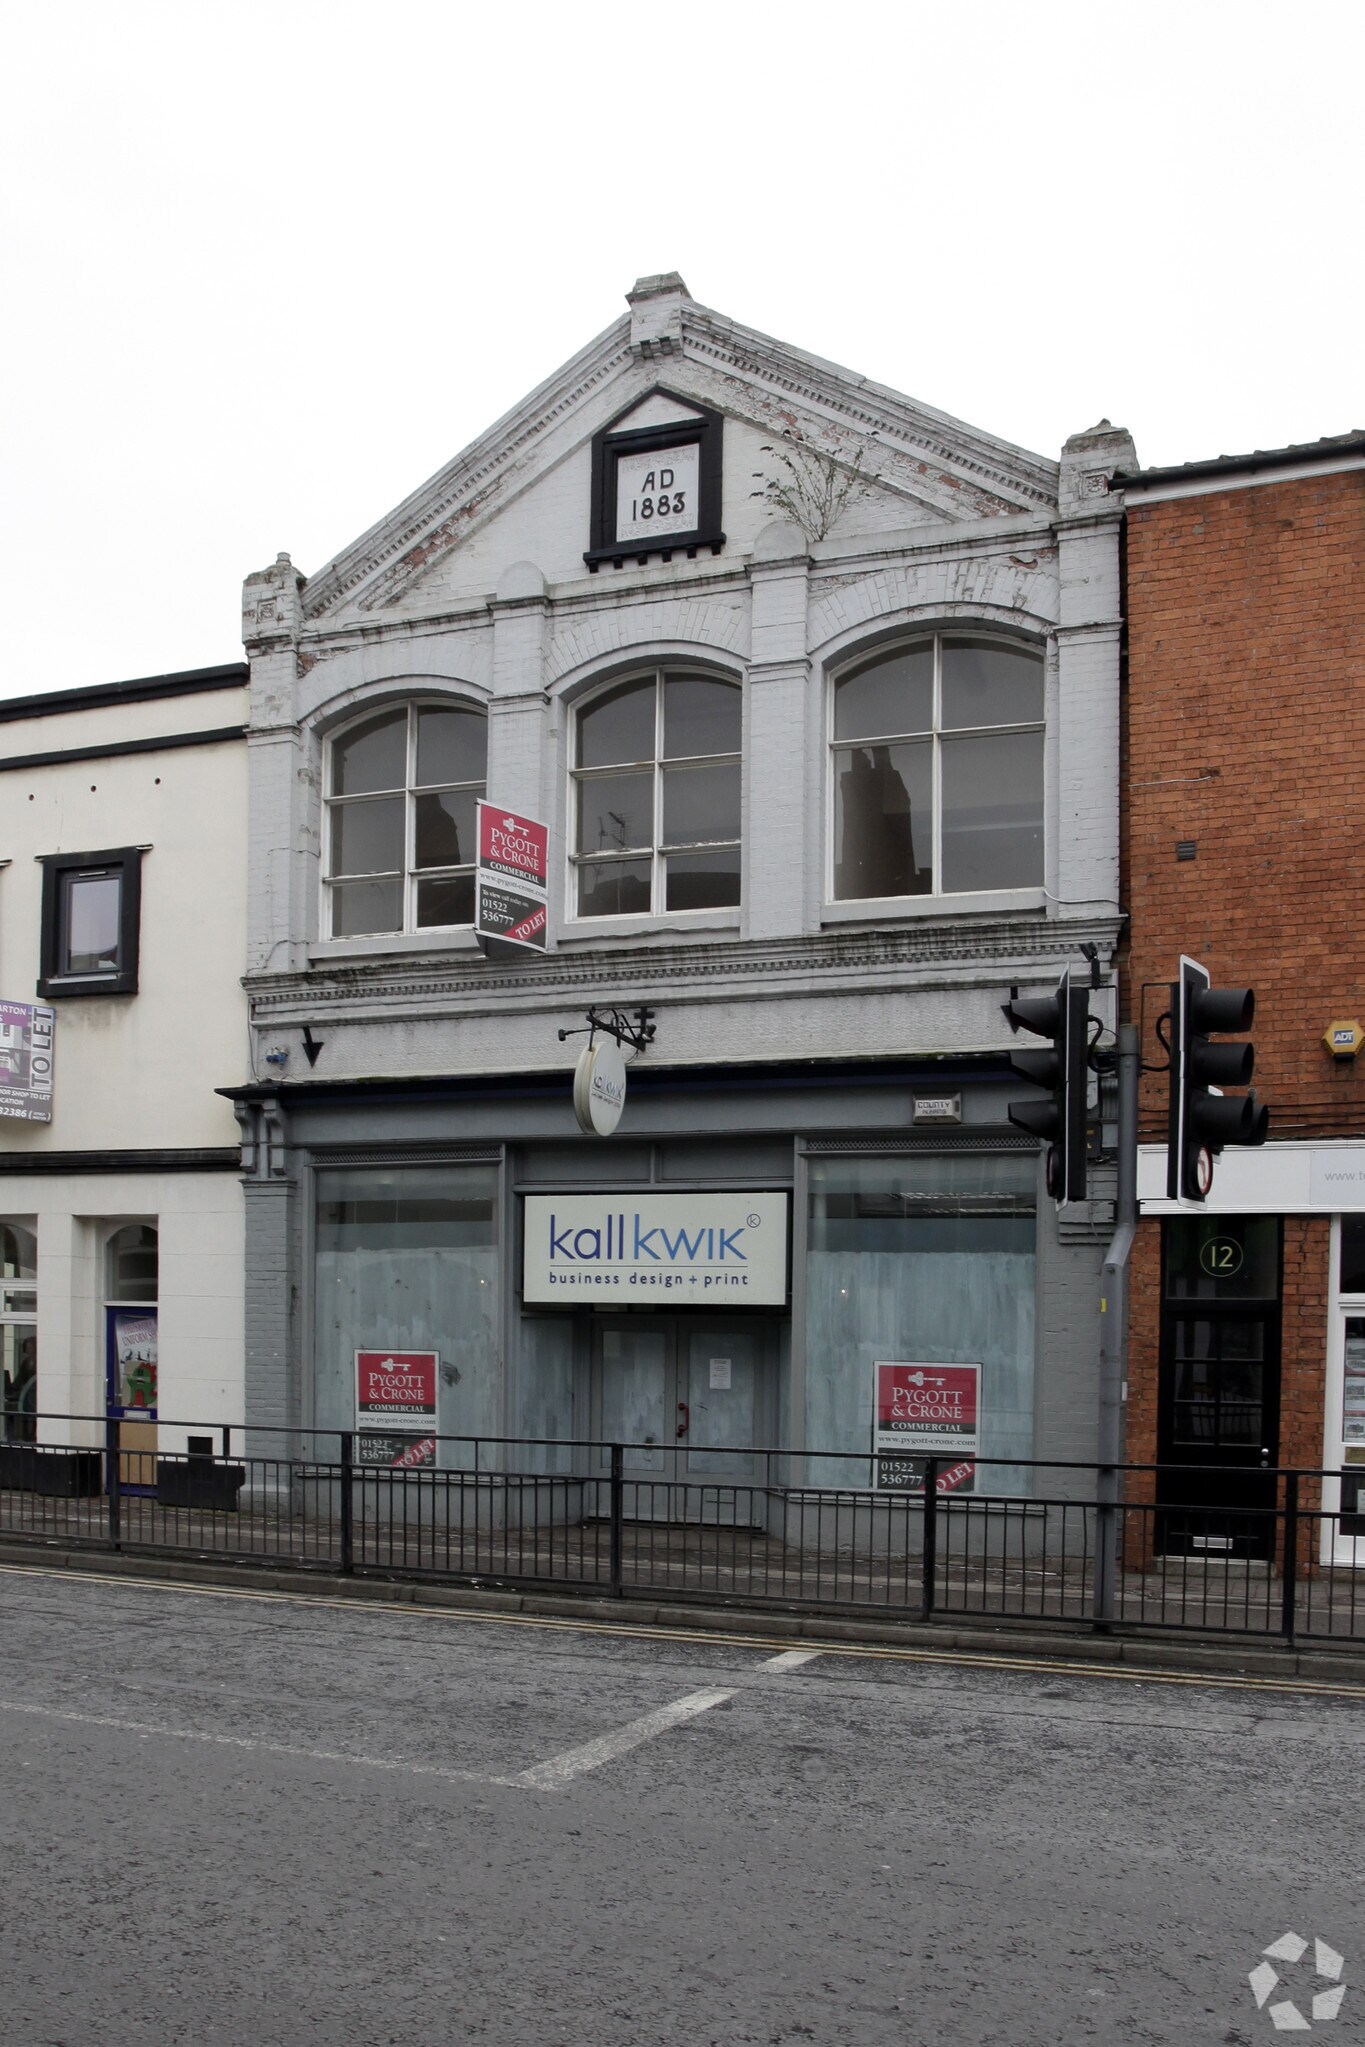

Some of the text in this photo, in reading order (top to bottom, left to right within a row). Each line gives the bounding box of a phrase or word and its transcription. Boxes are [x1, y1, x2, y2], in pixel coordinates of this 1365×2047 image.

[641, 469, 674, 493] AD
[632, 491, 686, 521] 1883
[490, 827, 540, 857] PYGOTT
[490, 844, 540, 871] & CRONE
[490, 861, 540, 884] COMMERCIAL
[479, 873, 547, 899] www.pygott-crone.com
[489, 891, 501, 899] view
[482, 898, 508, 913] 01522
[482, 910, 514, 926] 536777
[515, 912, 546, 940] TO LET
[1333, 1031, 1354, 1042] ADT
[31, 1008, 52, 1087] TO LET
[11, 1090, 30, 1098] SHOP
[917, 1101, 950, 1109] COUNTY
[1323, 1168, 1365, 1181] www.t
[1211, 1245, 1234, 1267] 12
[549, 1272, 620, 1285] business
[629, 1272, 683, 1288] design
[704, 1273, 749, 1288] print
[368, 1373, 425, 1388] PYGOTT
[368, 1387, 425, 1401] & CRONE
[891, 1387, 963, 1404] PYGOTT
[368, 1403, 425, 1412] COMMERCIAL
[891, 1403, 963, 1419] & CRONE
[359, 1417, 436, 1425] www.pygott-crone.com
[891, 1421, 963, 1432] COMMERCIAL
[413, 1439, 435, 1458] LET
[878, 1436, 976, 1446] www.pygott-crone.com
[361, 1449, 395, 1460] 536777
[881, 1461, 914, 1472] 01522
[946, 1462, 973, 1484] LET
[881, 1474, 923, 1485] 536777
